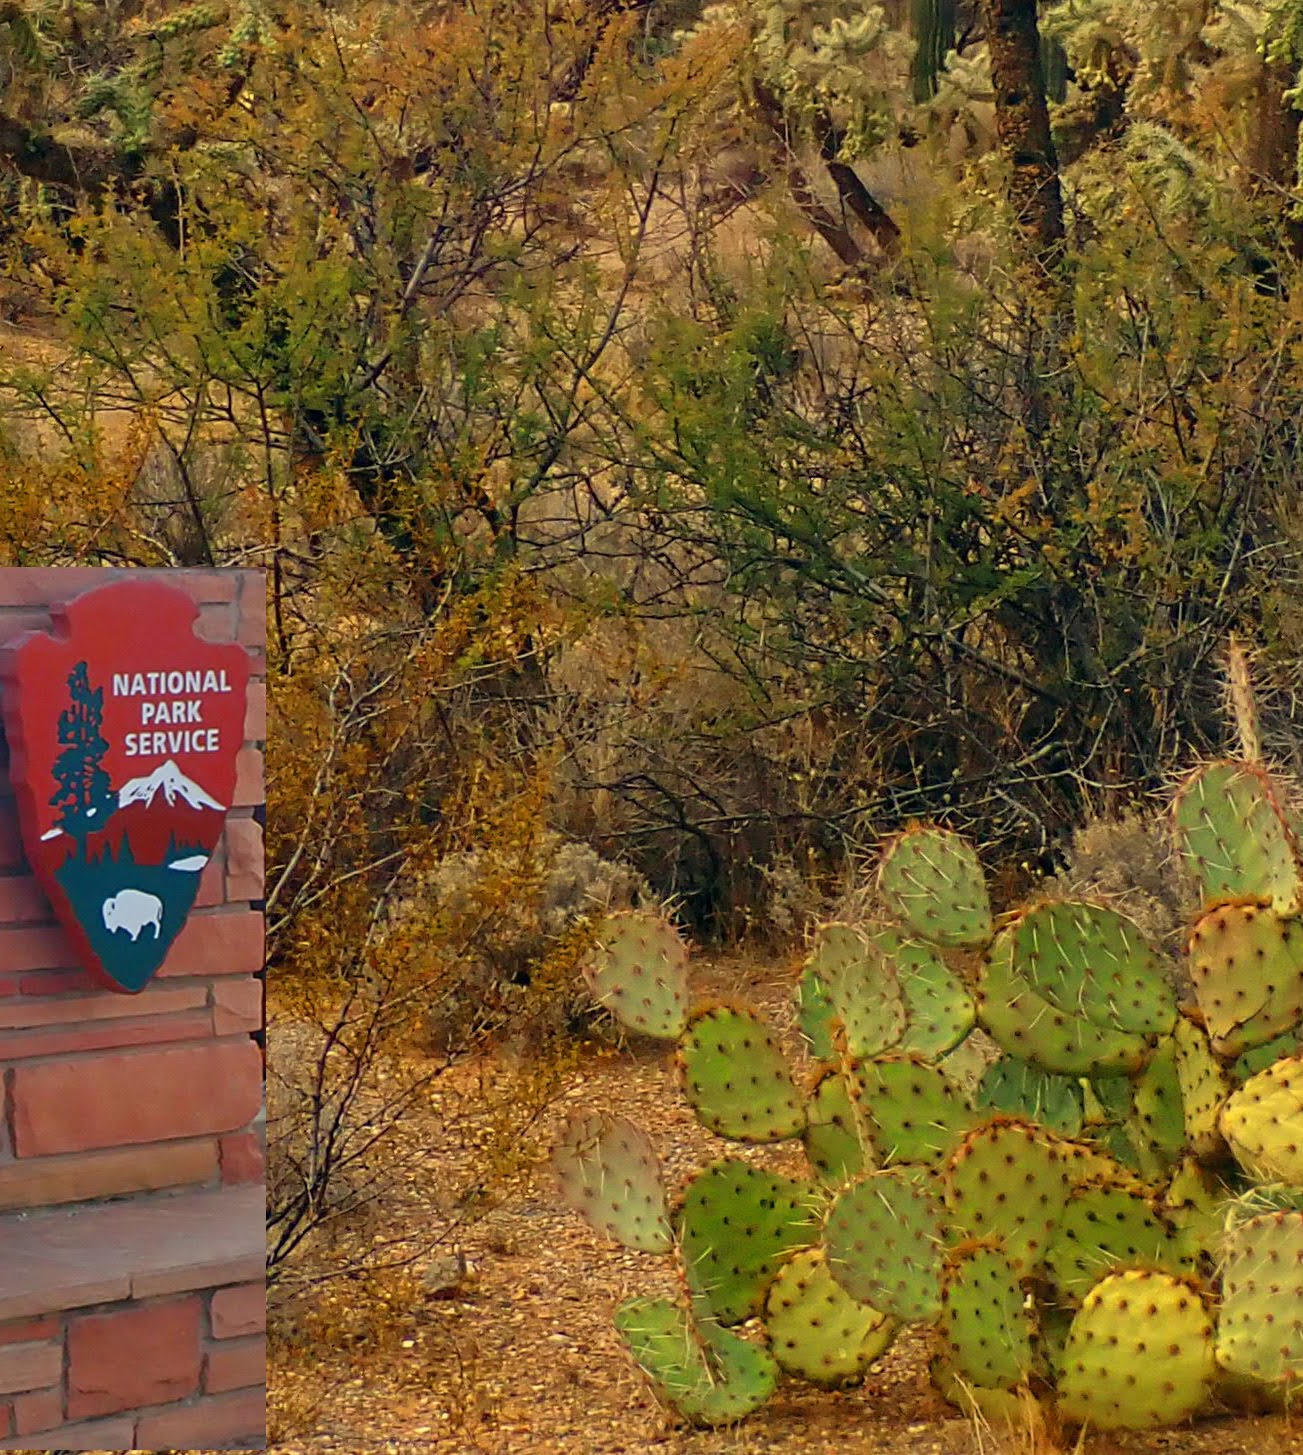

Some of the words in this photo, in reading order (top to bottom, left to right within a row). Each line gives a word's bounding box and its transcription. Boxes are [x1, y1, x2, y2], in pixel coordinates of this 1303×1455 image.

[113, 670, 232, 696] NATIONAL
[141, 700, 202, 725] PARK
[125, 728, 219, 756] SERVICE
